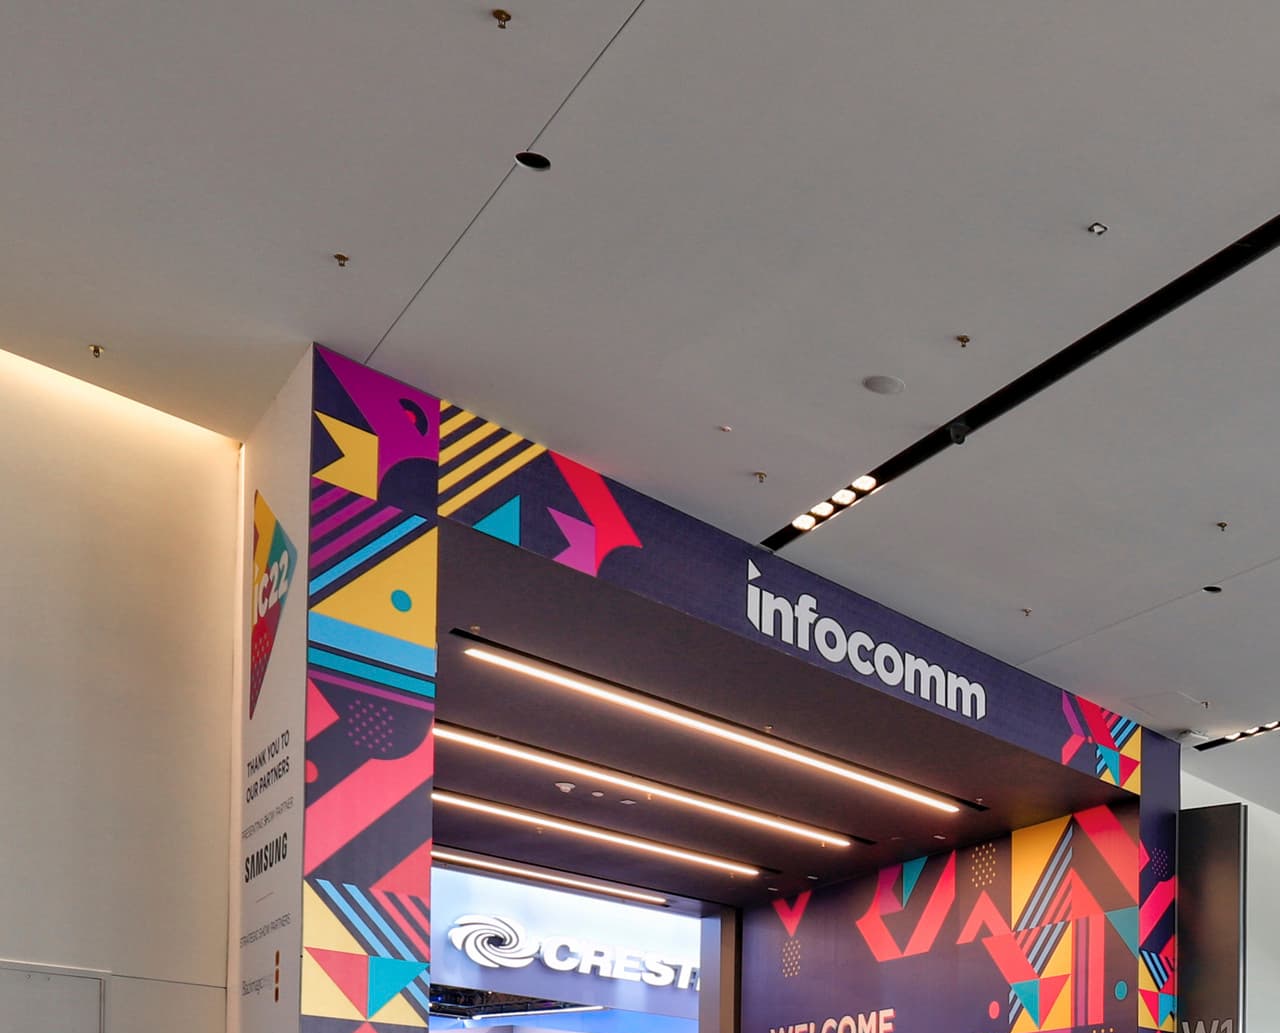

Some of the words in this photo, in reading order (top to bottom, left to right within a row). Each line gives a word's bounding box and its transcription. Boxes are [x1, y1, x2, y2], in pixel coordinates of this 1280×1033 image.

[747, 559, 986, 720] infocomm
[247, 749, 266, 778] THANK
[267, 737, 280, 761] YOU
[281, 729, 290, 750] TO
[246, 781, 258, 803] OUR
[259, 756, 290, 794] PARTNERS
[245, 832, 288, 883] SAMSUNG
[543, 935, 700, 991] CREST
